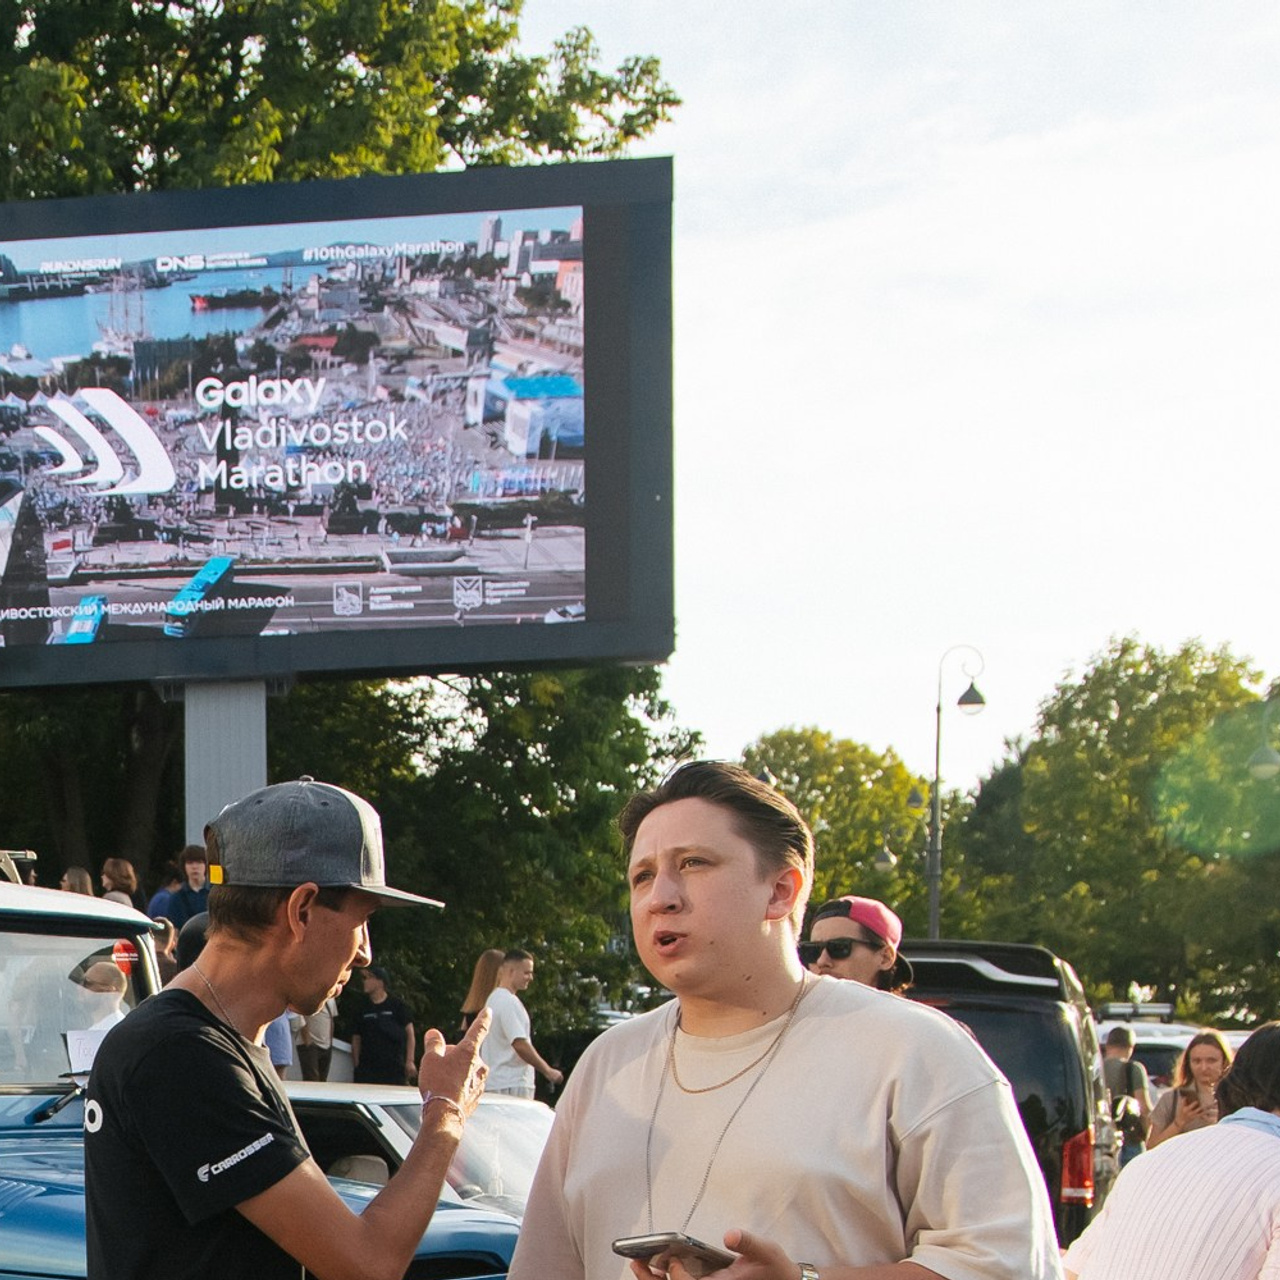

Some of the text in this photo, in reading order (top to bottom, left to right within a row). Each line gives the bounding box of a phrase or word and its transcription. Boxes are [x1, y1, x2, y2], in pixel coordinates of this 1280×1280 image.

[156, 254, 204, 272] DNS
[303, 239, 465, 262] #10thGalaxyMarathon
[195, 374, 326, 413] Galaxy
[197, 411, 409, 451] Vladivostok
[197, 455, 367, 491] Marathon
[101, 597, 225, 615] МЕЖДУНАРОДНЫЙ
[228, 595, 295, 610] МАРАФОН
[210, 1132, 275, 1176] CARROSSER
